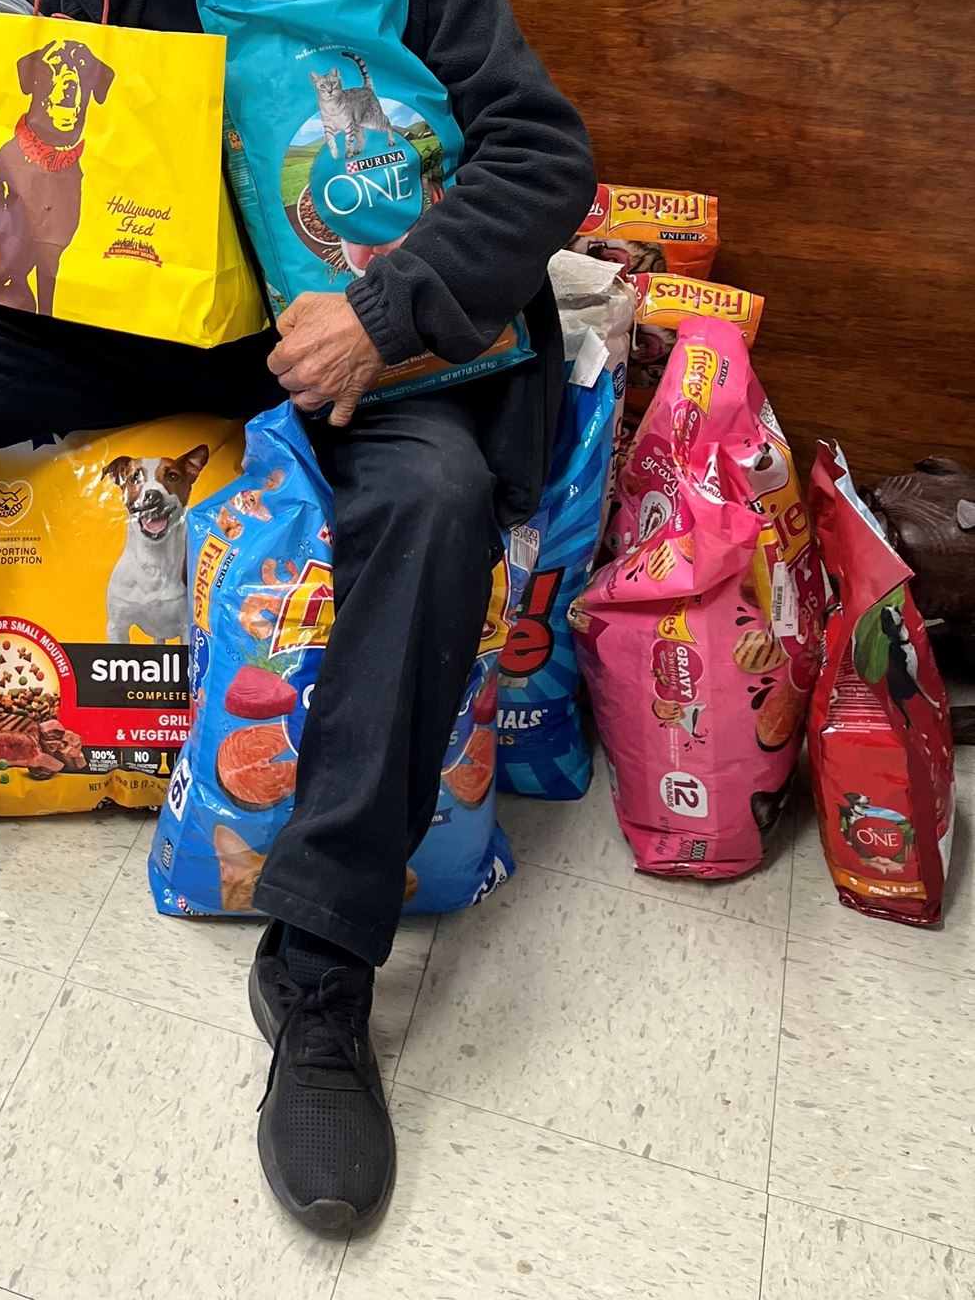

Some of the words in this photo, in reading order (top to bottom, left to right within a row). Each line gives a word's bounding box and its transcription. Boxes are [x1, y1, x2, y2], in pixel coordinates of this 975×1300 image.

[359, 151, 404, 170] PURINA
[323, 163, 413, 215] ONE
[106, 195, 171, 221] Hollywood
[616, 192, 700, 221] Friskies
[116, 215, 156, 236] Feed
[661, 231, 698, 241] PURINA
[655, 283, 743, 316] Friskies
[441, 374, 452, 382] NET
[452, 372, 461, 381] WT
[462, 371, 466, 379] 7
[466, 369, 473, 378] LB
[688, 348, 712, 403] Friskies
[194, 541, 223, 618] Friskies
[10, 620, 39, 639] SMALL
[39, 634, 70, 677] MOUTHS!
[91, 653, 180, 683] small
[675, 645, 692, 699] GRAVY
[127, 690, 187, 701] COMPLETE
[115, 728, 126, 741] &
[91, 750, 116, 760] 100%
[134, 751, 150, 763] NO
[89, 781, 102, 791] NET
[130, 779, 138, 789] LB
[665, 776, 675, 808] POUNDS
[674, 778, 699, 809] 12
[856, 828, 899, 847] ONE
